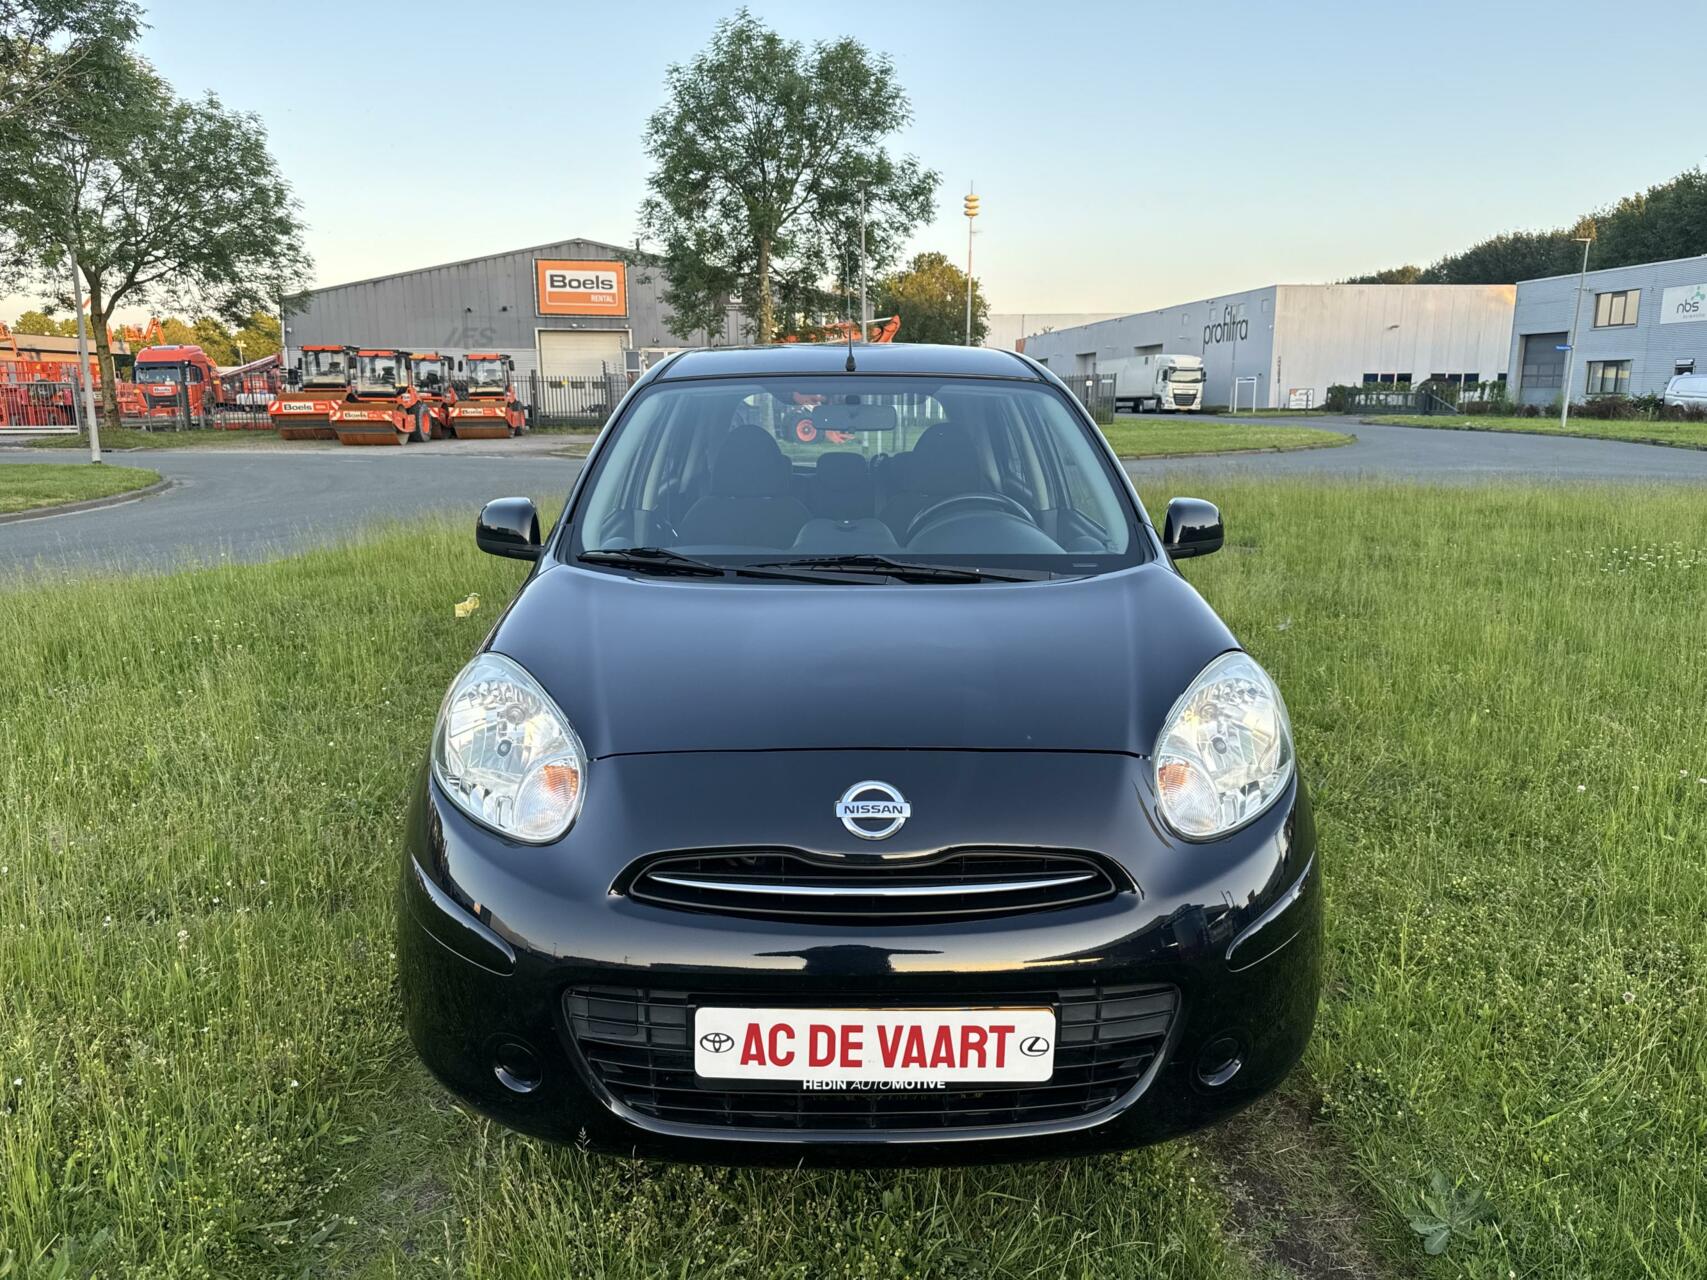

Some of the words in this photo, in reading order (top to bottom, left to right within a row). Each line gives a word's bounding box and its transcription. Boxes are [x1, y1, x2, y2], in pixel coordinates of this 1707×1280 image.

[549, 274, 614, 290] Boels
[590, 294, 615, 303] RENTAL
[1676, 298, 1700, 313] nbs
[1202, 303, 1249, 355] profiltra
[844, 805, 903, 814] NISSAN
[740, 1023, 795, 1066] AC
[808, 1024, 863, 1068] DE
[876, 1025, 1015, 1069] VAART
[803, 1080, 847, 1090] HEDIN
[850, 1080, 946, 1090] AUTOMOTIVE
